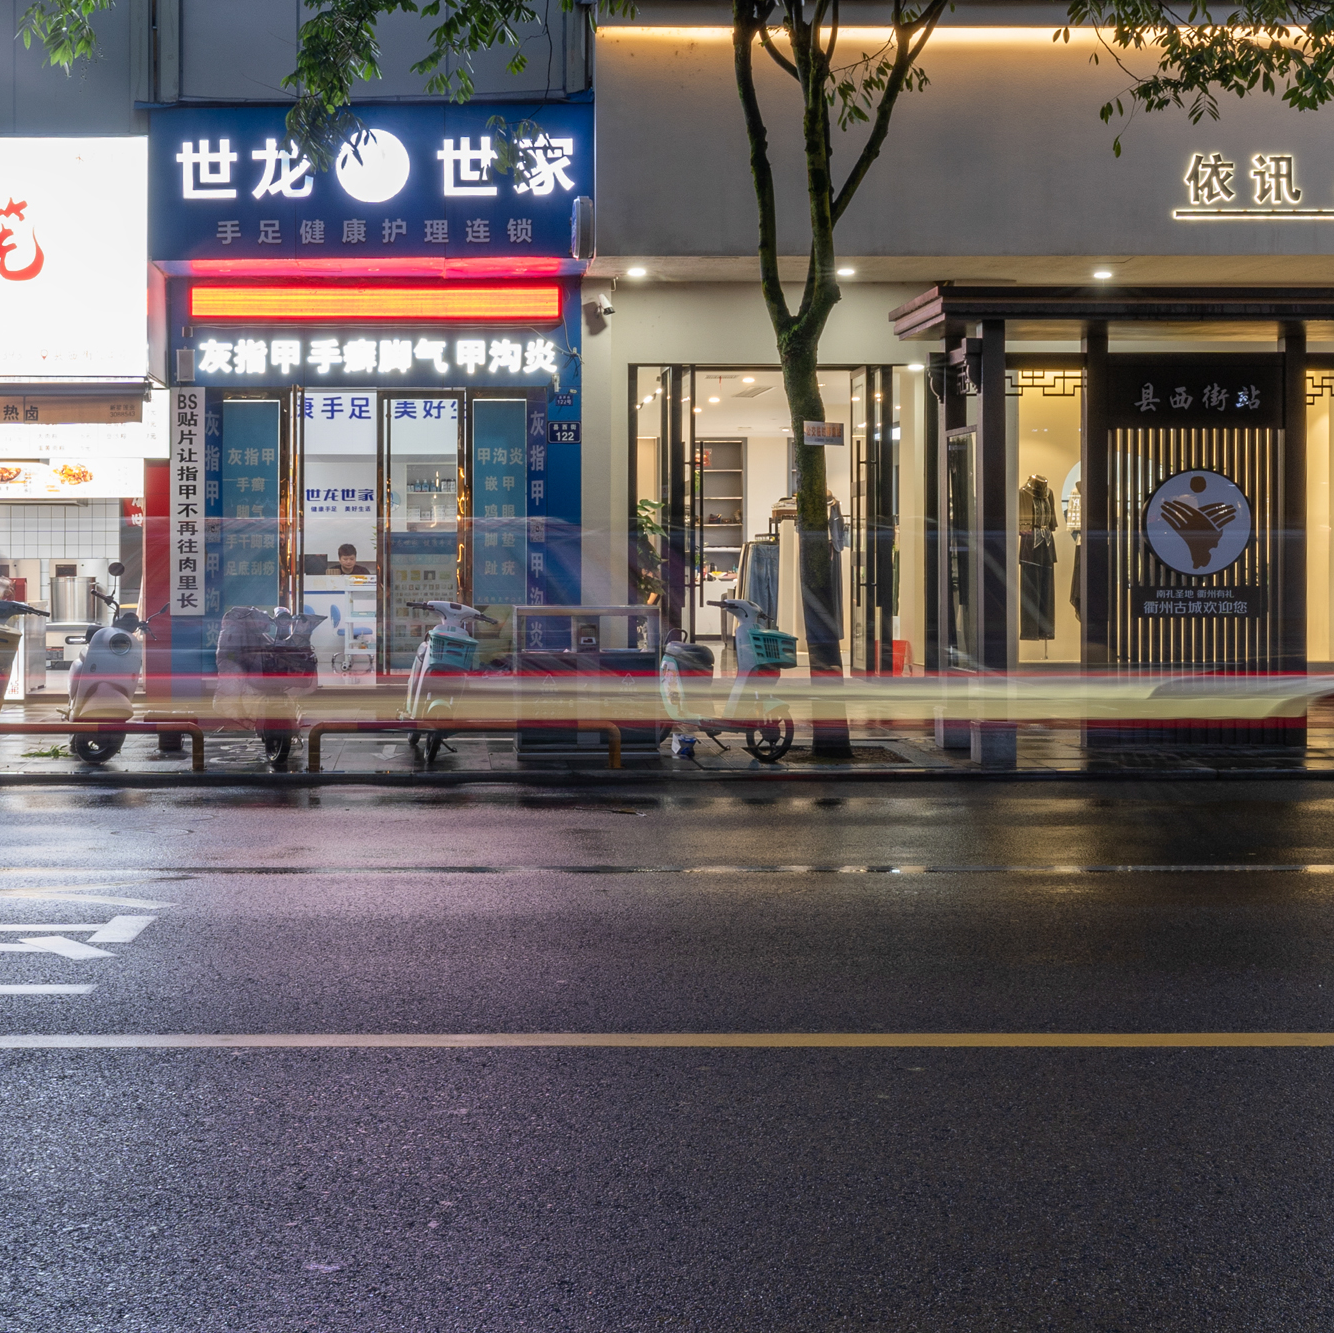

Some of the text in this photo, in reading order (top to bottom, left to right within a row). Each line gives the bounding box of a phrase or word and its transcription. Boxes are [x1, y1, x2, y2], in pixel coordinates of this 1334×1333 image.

[176, 133, 576, 199] 世龙 世家
[1184, 153, 1301, 204] 依讯
[216, 219, 533, 245] 手足健康护理连锁
[199, 338, 302, 374] 灰指甲
[456, 339, 558, 374] 甲沟炎
[1134, 382, 1261, 411] 县西街站
[556, 432, 574, 441] 122
[227, 448, 275, 466] 灰指甲
[477, 448, 523, 465] 甲沟炎
[530, 410, 545, 506] 灰指甲
[236, 477, 265, 493] 手癣
[485, 476, 515, 491] 嵌甲
[176, 393, 198, 608] BS贴片让指甲不再往肉里长
[305, 488, 375, 502] 世龙世家
[484, 504, 515, 518] 鸡眼
[484, 532, 515, 548] 脚垫
[1156, 590, 1234, 598] 南孔圣地 衢州有礼
[1143, 600, 1248, 614] 衢州古城欢迎您
